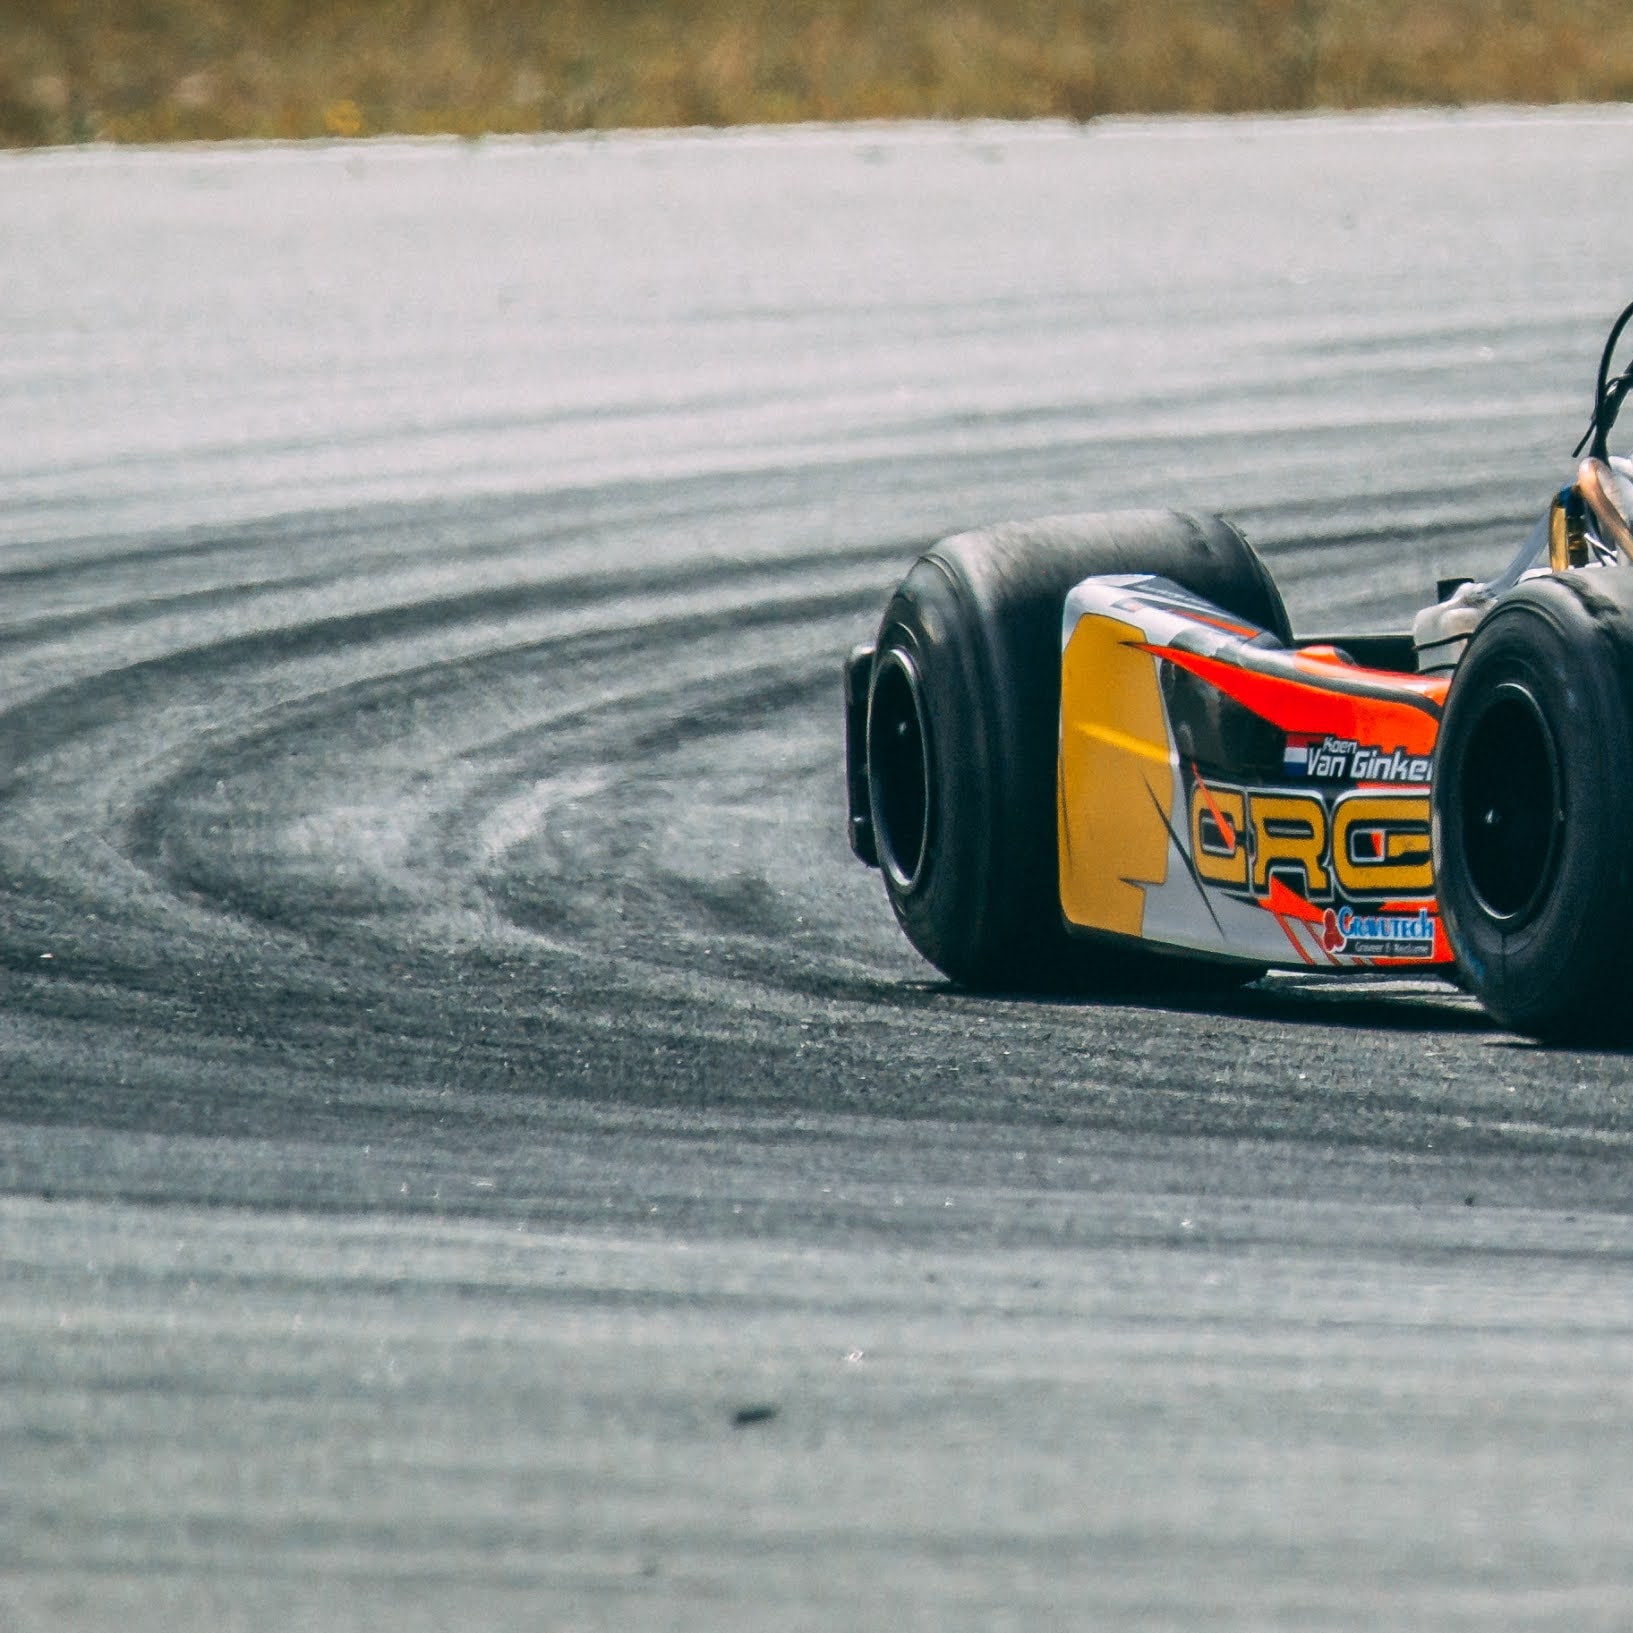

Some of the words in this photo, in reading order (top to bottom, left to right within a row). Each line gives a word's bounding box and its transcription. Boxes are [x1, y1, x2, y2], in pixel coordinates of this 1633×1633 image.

[1322, 736, 1357, 754] Koen
[1306, 747, 1345, 778] Van
[1190, 781, 1437, 901] CRG
